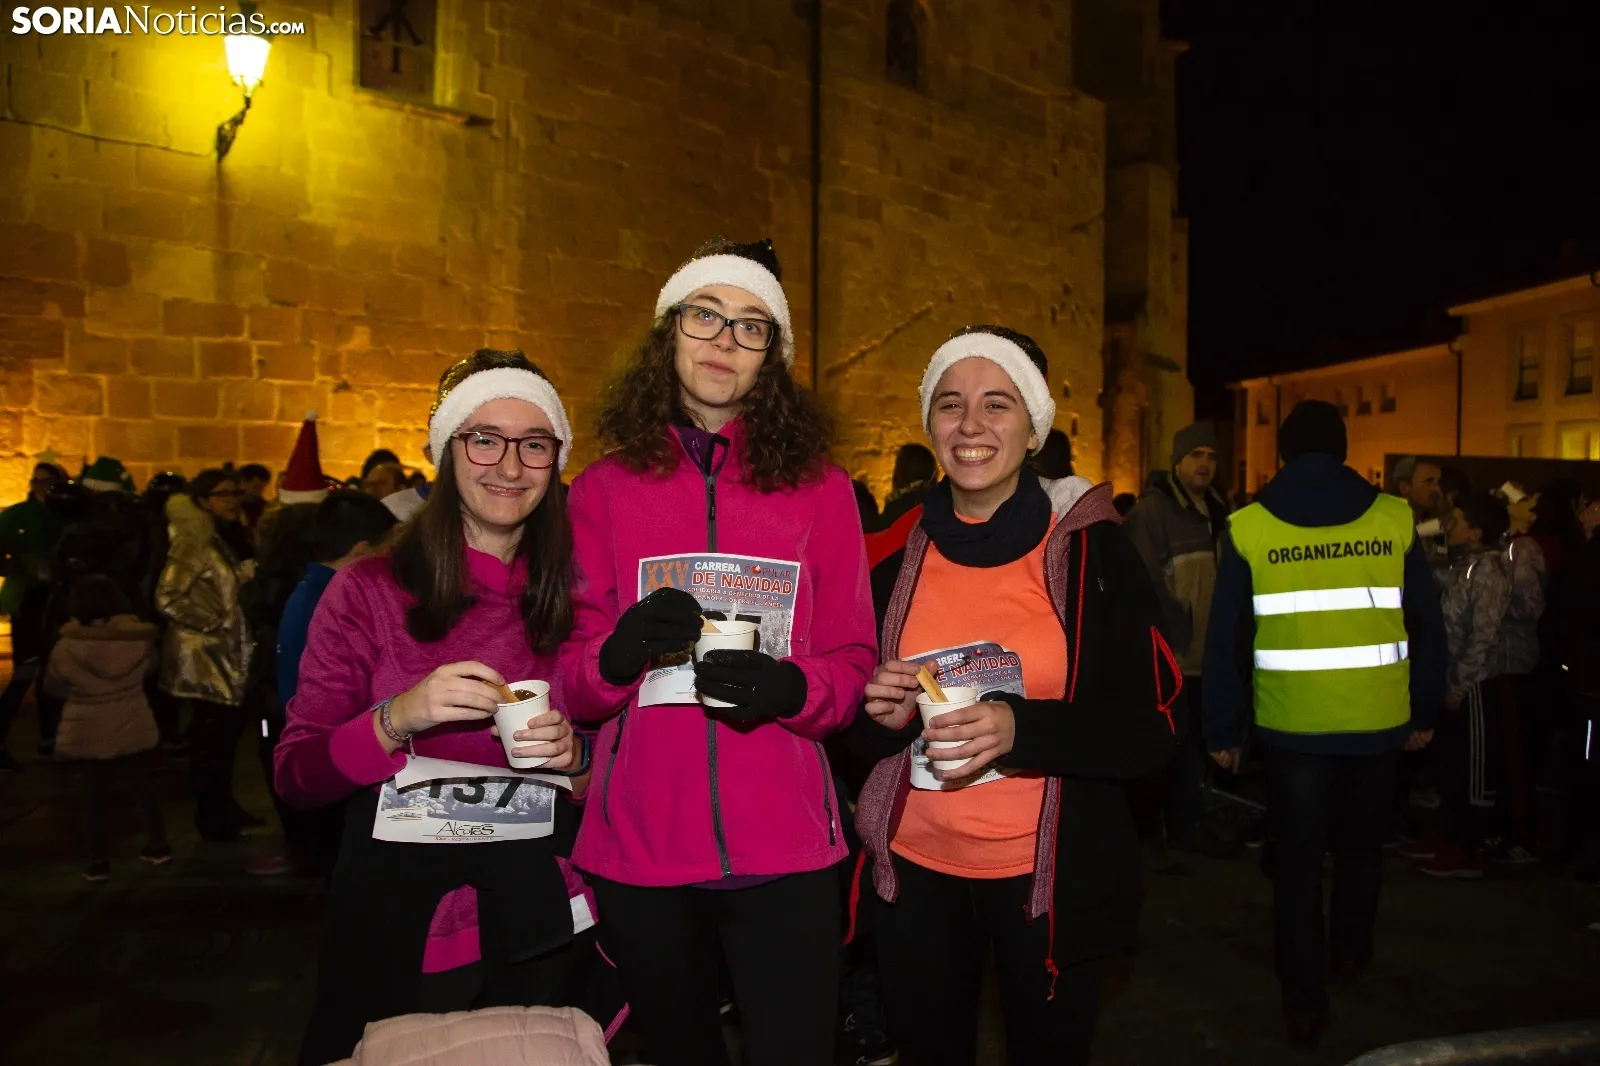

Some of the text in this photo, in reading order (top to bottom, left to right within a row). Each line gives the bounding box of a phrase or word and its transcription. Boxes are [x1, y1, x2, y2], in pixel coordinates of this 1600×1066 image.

[1267, 536, 1393, 565] ORGANIZACIÓN
[644, 560, 690, 591] XXV
[694, 561, 742, 574] CARRERA
[691, 571, 793, 595] DE NAVIDAD
[949, 655, 1020, 678] NAVIDAD
